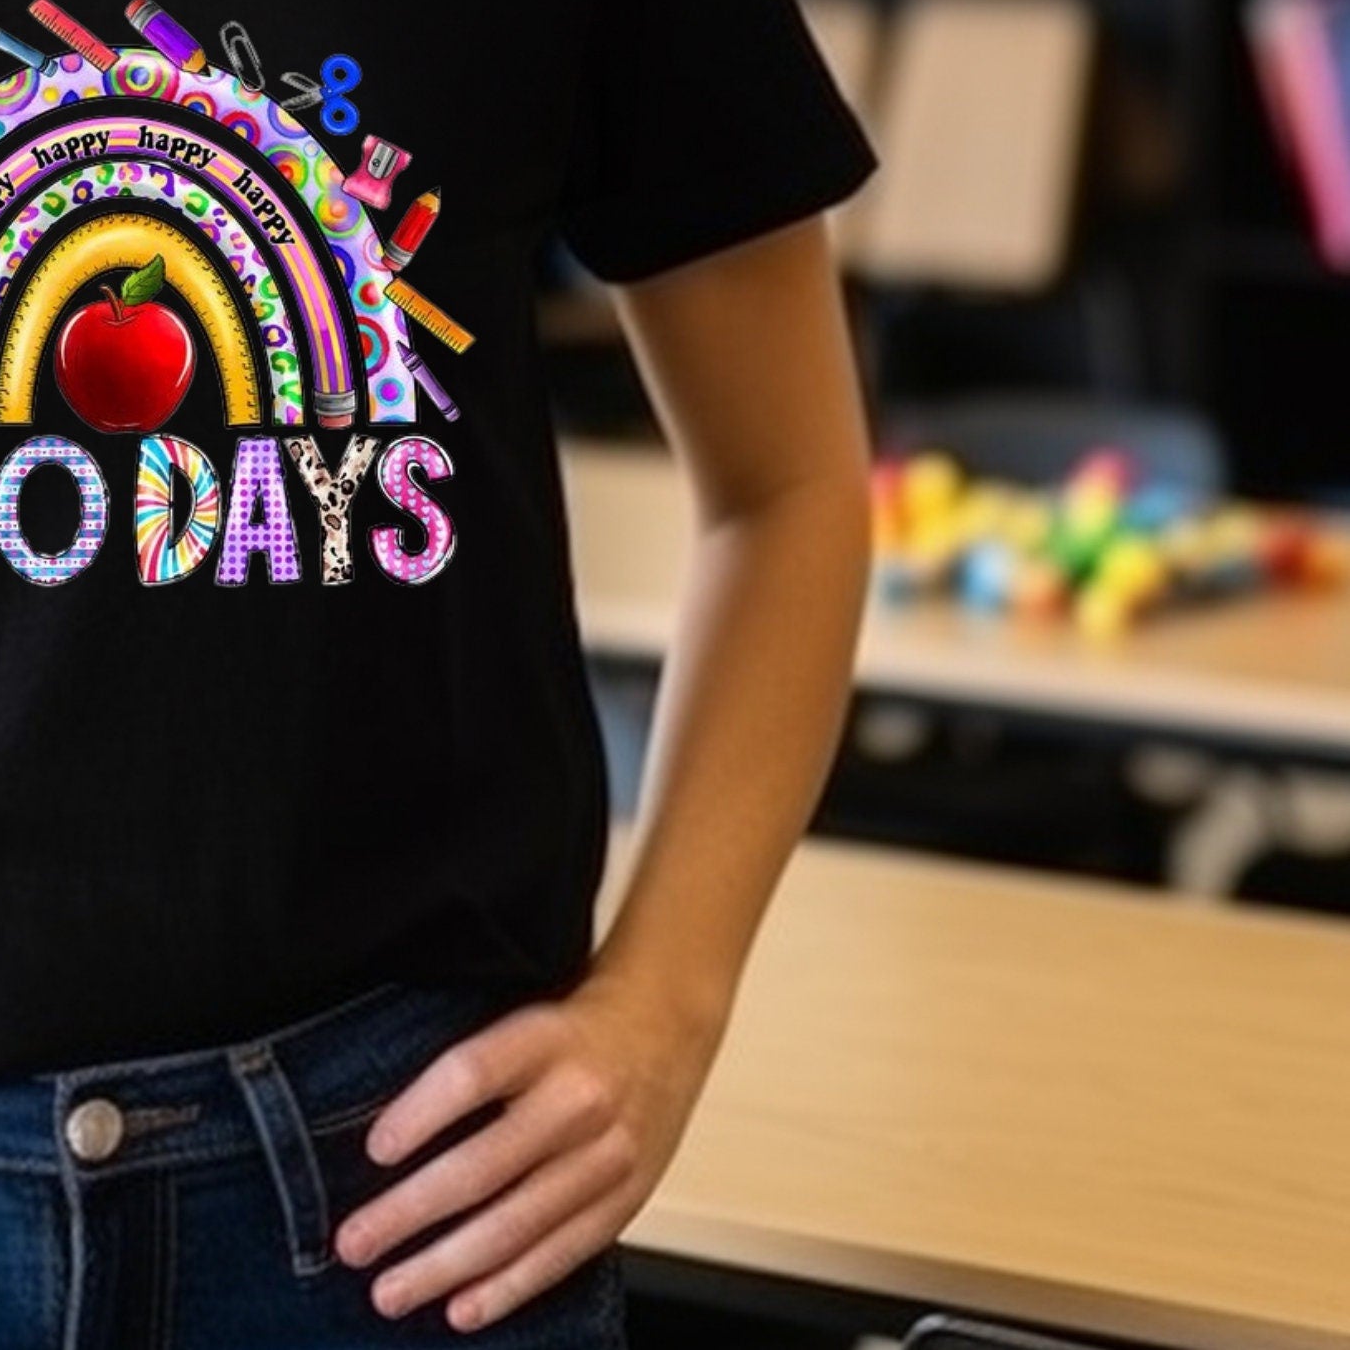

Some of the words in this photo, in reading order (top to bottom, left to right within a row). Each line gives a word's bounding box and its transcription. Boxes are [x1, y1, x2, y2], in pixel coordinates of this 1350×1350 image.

[31, 129, 112, 169] happy
[138, 125, 217, 169] happy
[232, 168, 295, 247] happy
[133, 432, 457, 587] DAYS
